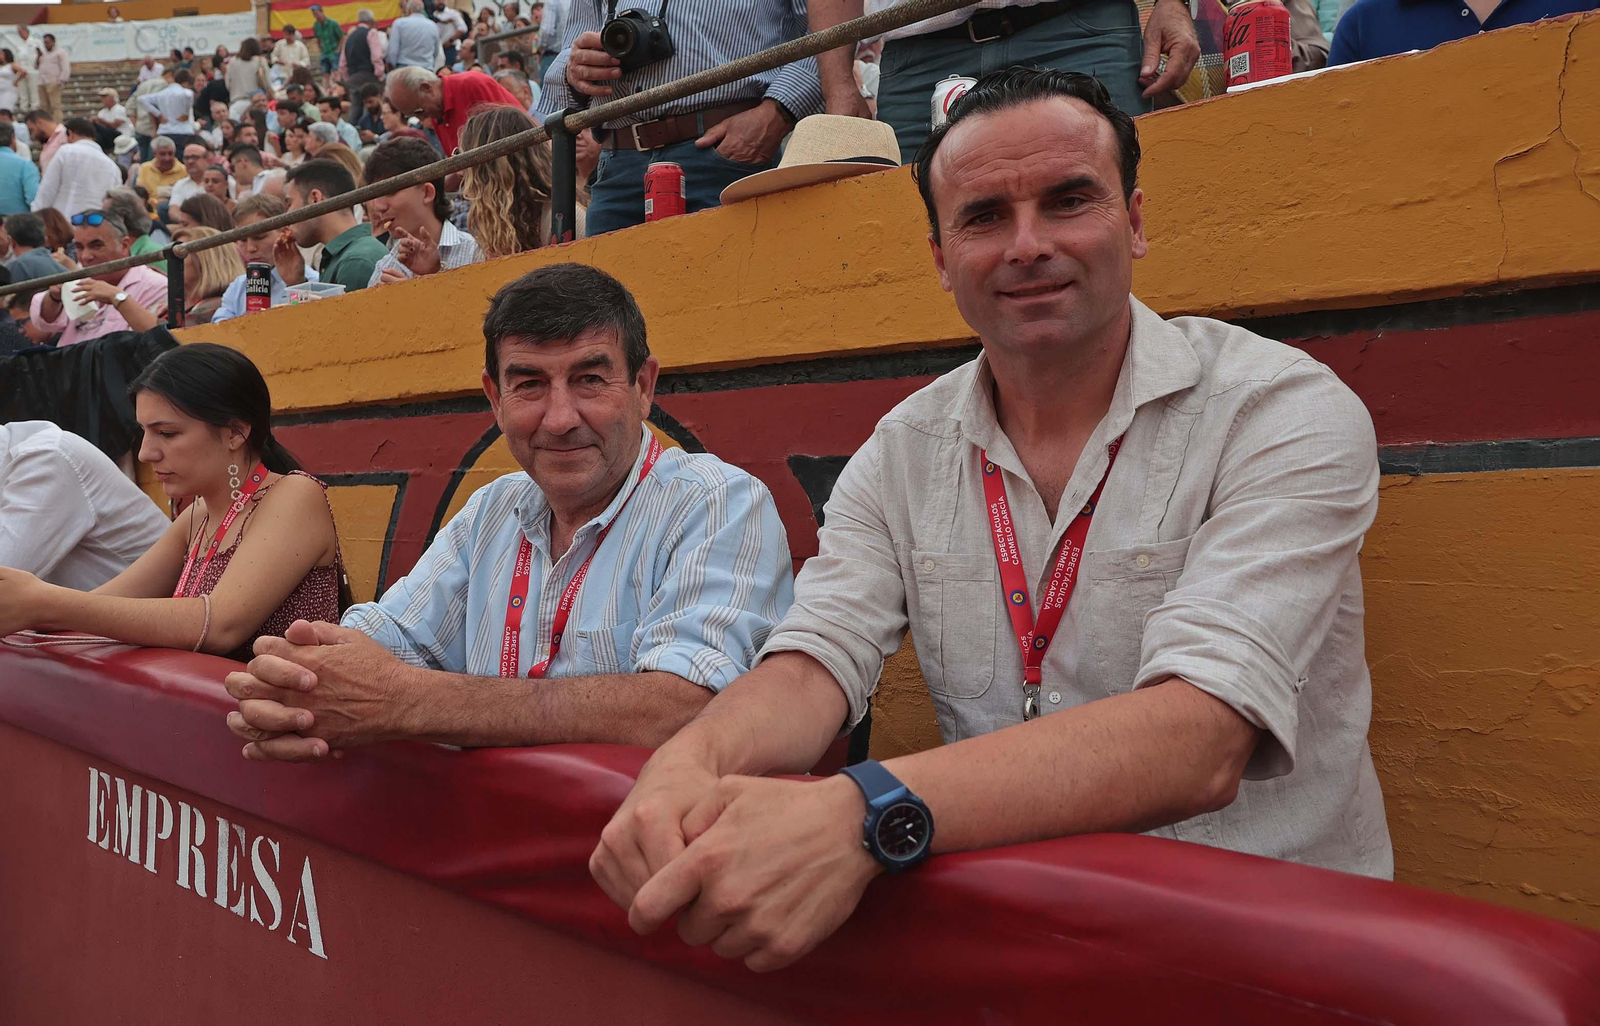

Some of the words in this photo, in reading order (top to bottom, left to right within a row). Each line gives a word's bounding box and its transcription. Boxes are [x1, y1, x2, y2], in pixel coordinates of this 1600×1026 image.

[158, 21, 178, 38] de
[998, 495, 1010, 525] GARCÍA
[991, 503, 1009, 562] ESPECTÁCULOS
[1005, 526, 1019, 565] CARMELO
[515, 552, 525, 578] GARCÍA
[1054, 539, 1072, 578] CARMELO
[1043, 580, 1058, 610] GARCÍA
[1055, 546, 1080, 609] ESPECTÁCULOS
[502, 626, 511, 660] CARMELO
[87, 766, 328, 960] EMPRESA
